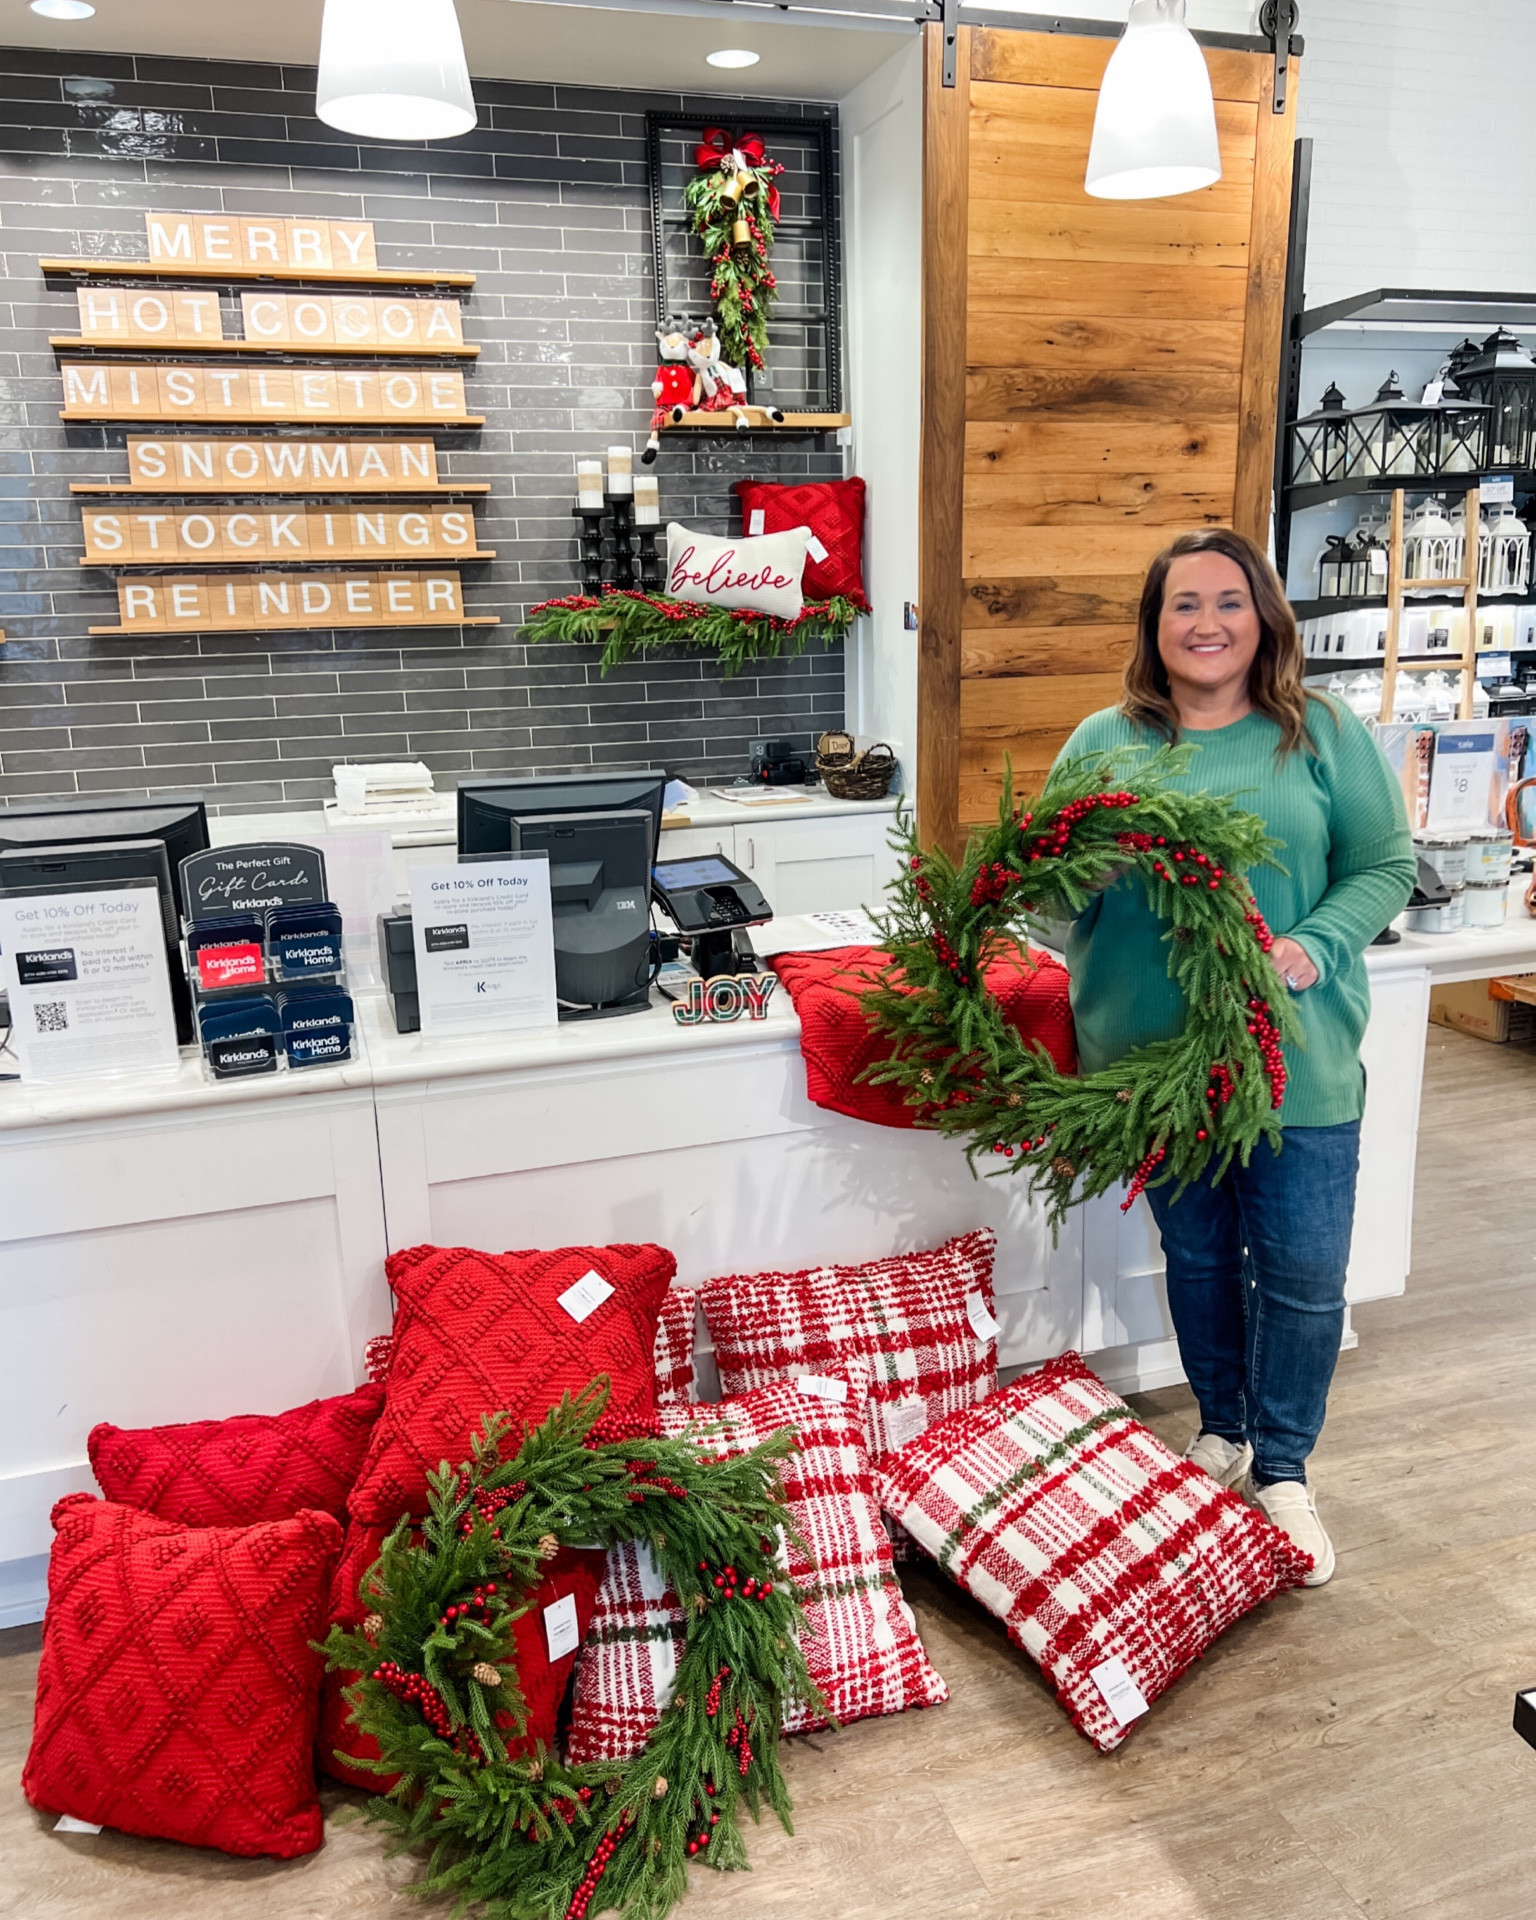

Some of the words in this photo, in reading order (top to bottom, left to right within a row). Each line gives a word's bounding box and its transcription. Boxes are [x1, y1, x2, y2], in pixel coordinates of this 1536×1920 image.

[150, 222, 368, 264] MERRY
[87, 295, 214, 333] HOT
[248, 300, 457, 339] COCOA
[66, 369, 458, 410] MISTLETOE
[136, 442, 430, 479] SNOWMAN
[93, 512, 469, 550] STOCKINGS
[671, 546, 794, 594] believe
[125, 579, 455, 618] REINDEER
[216, 862, 234, 871] The
[236, 859, 271, 869] Perfect
[273, 857, 291, 866] Gift
[198, 876, 247, 901] Gift
[251, 870, 309, 891] Cards
[431, 882, 450, 890] Get
[454, 881, 474, 889] 10%
[478, 879, 493, 887] Off
[497, 877, 528, 886] Today
[232, 896, 283, 910] Kirkland's
[616, 900, 636, 910] IBM
[15, 910, 39, 921] Get
[44, 906, 70, 918] 10%
[74, 904, 94, 916] Off
[100, 902, 139, 914] Today
[280, 928, 329, 941] Kirkland's
[25, 951, 73, 963] Kirkland's
[96, 947, 126, 956] interest
[285, 945, 333, 960] Kirkland's
[82, 957, 100, 967] paid
[103, 956, 111, 964] in
[113, 954, 125, 963] full
[127, 953, 153, 962] within
[206, 955, 256, 970] Kirkland's
[304, 955, 334, 965] Home
[102, 965, 110, 973] 12
[226, 965, 257, 975] Home
[671, 972, 778, 1026] JOY
[292, 1015, 341, 1030] Kirkland's
[292, 1035, 340, 1050] Kirkland's
[220, 1049, 269, 1064] Kirkland's
[311, 1045, 341, 1056] Home
